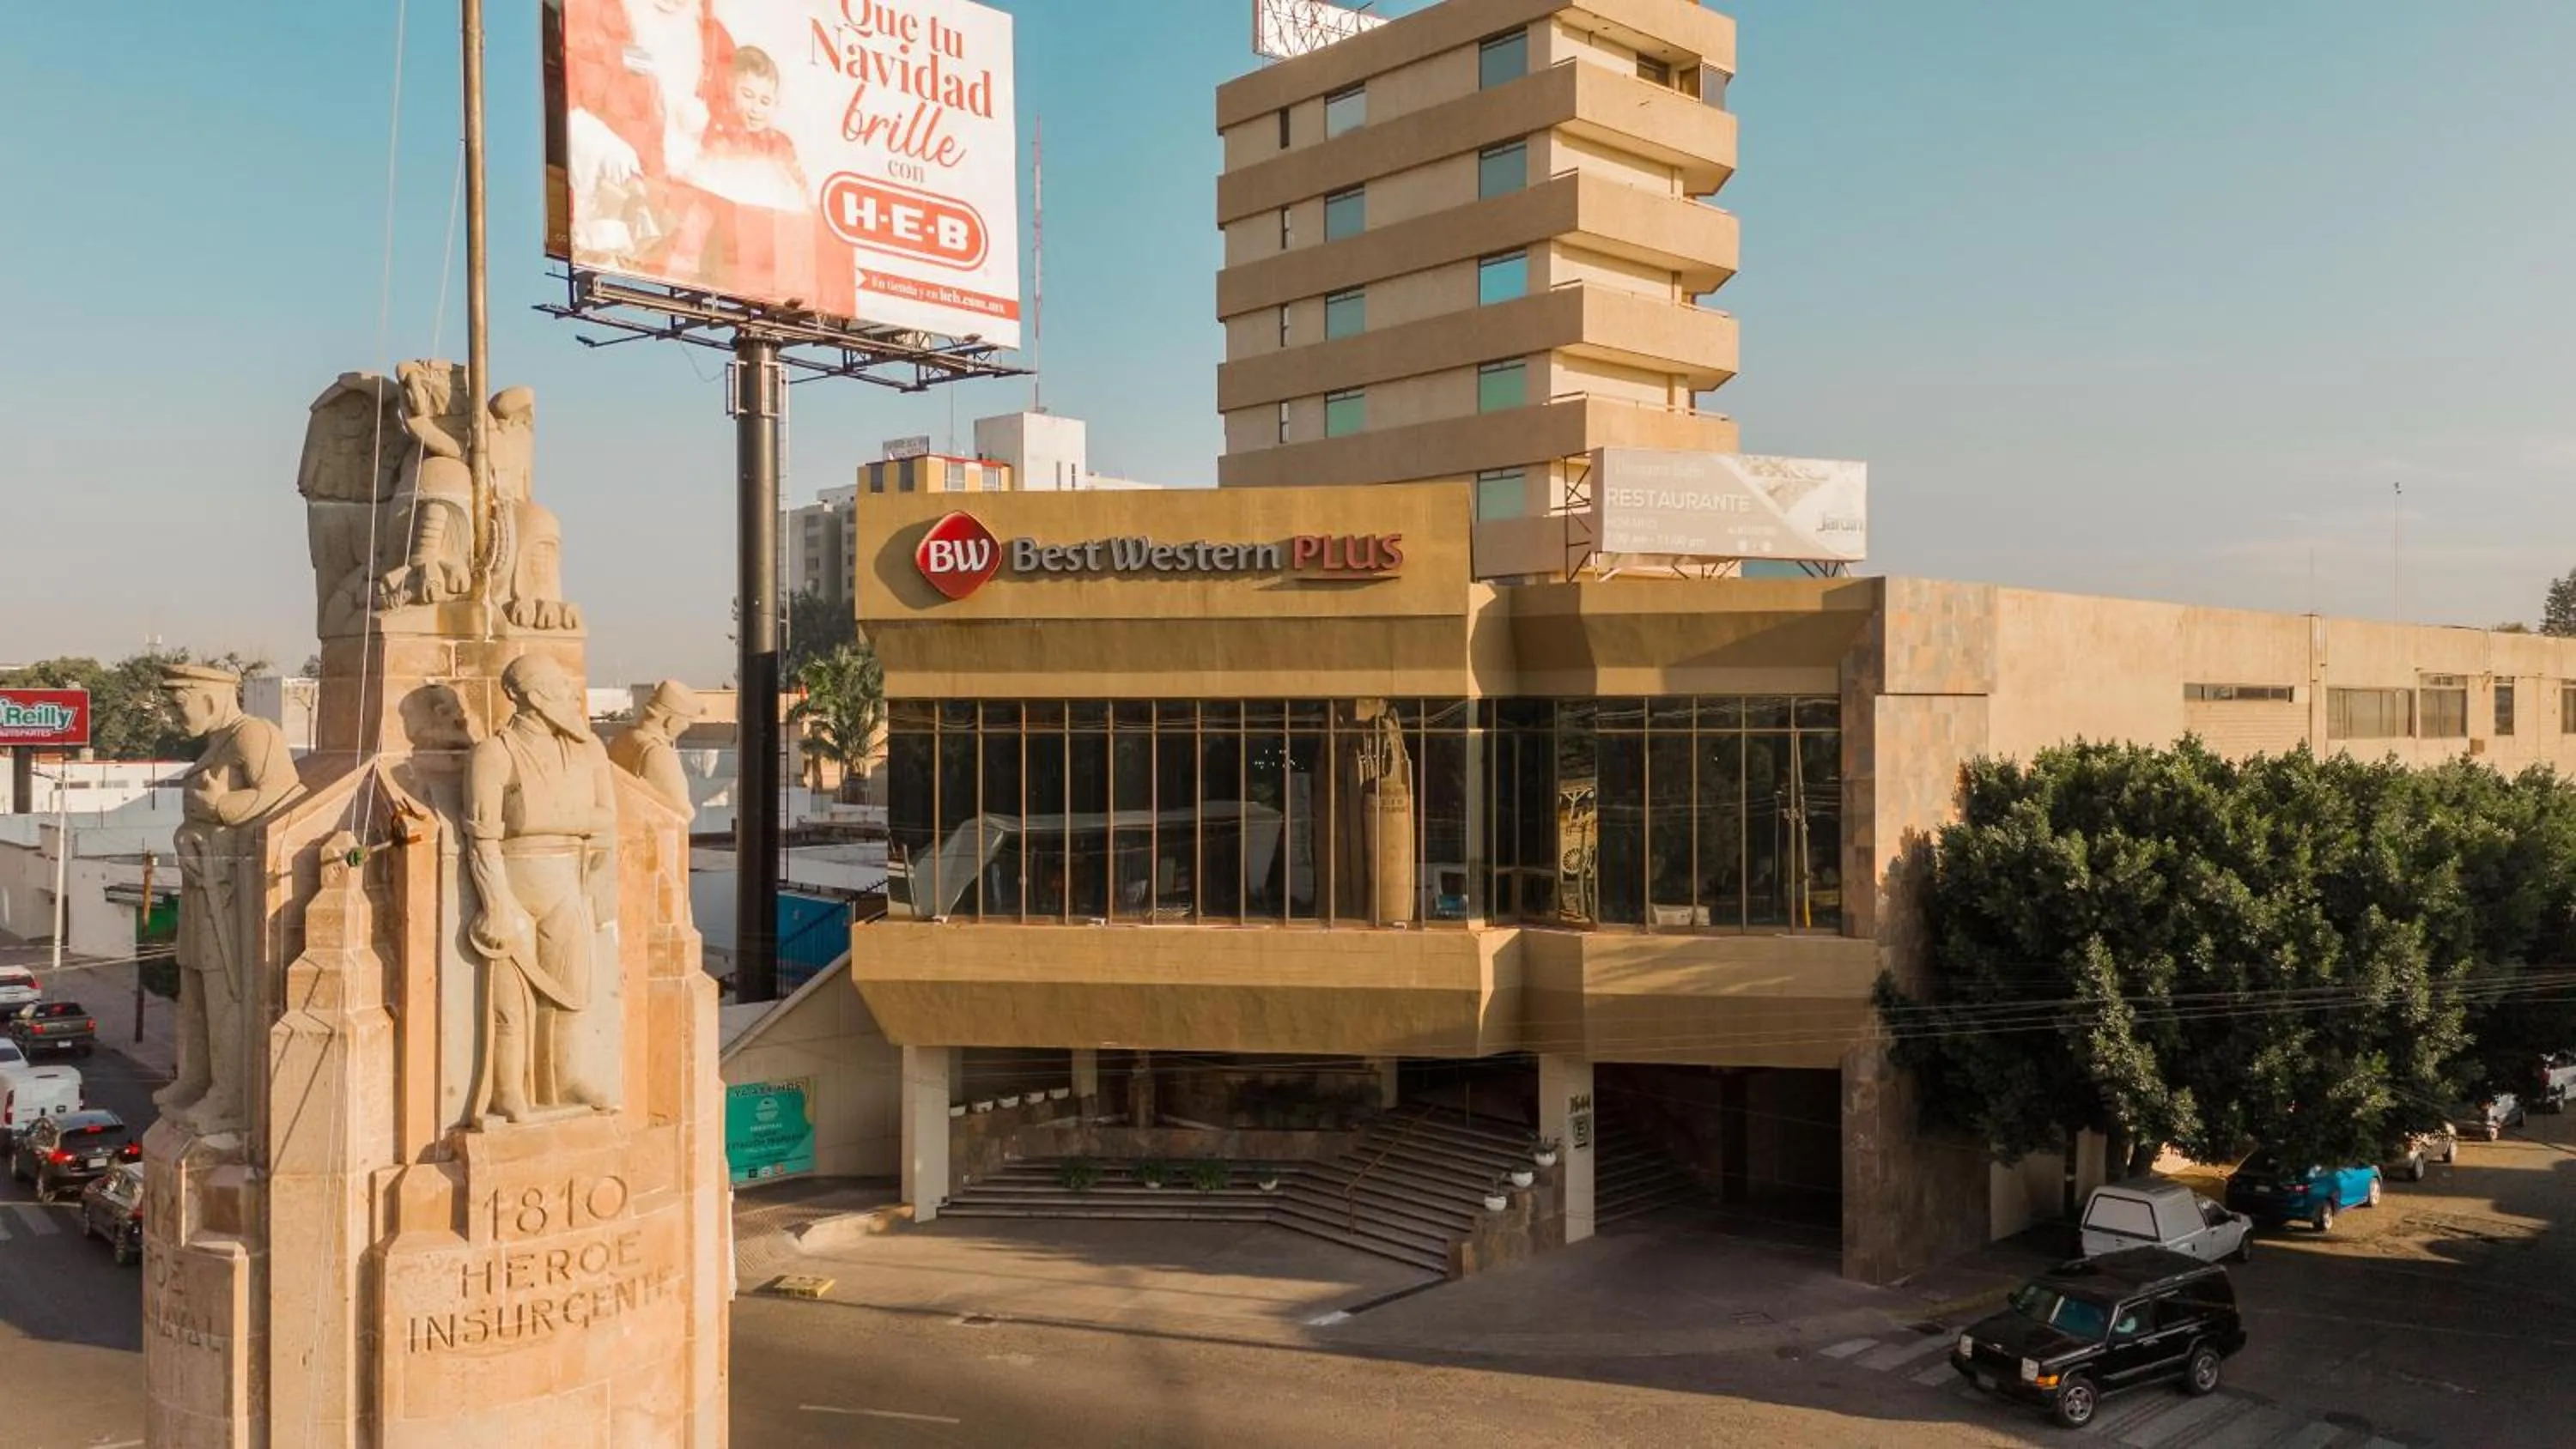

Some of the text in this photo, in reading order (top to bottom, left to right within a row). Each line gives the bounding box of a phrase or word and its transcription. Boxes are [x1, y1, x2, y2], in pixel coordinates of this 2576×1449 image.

[841, 0, 963, 59] Que tu
[810, 16, 993, 119] Navidad
[841, 83, 967, 167] brille
[887, 159, 925, 184] con
[887, 279, 917, 296] tienda
[1606, 487, 1751, 512] RESTAURANTE
[928, 538, 991, 573] BW
[1012, 533, 1404, 573] Best Western PLUS
[483, 1175, 628, 1241] 1810
[461, 1229, 641, 1299] HEROE
